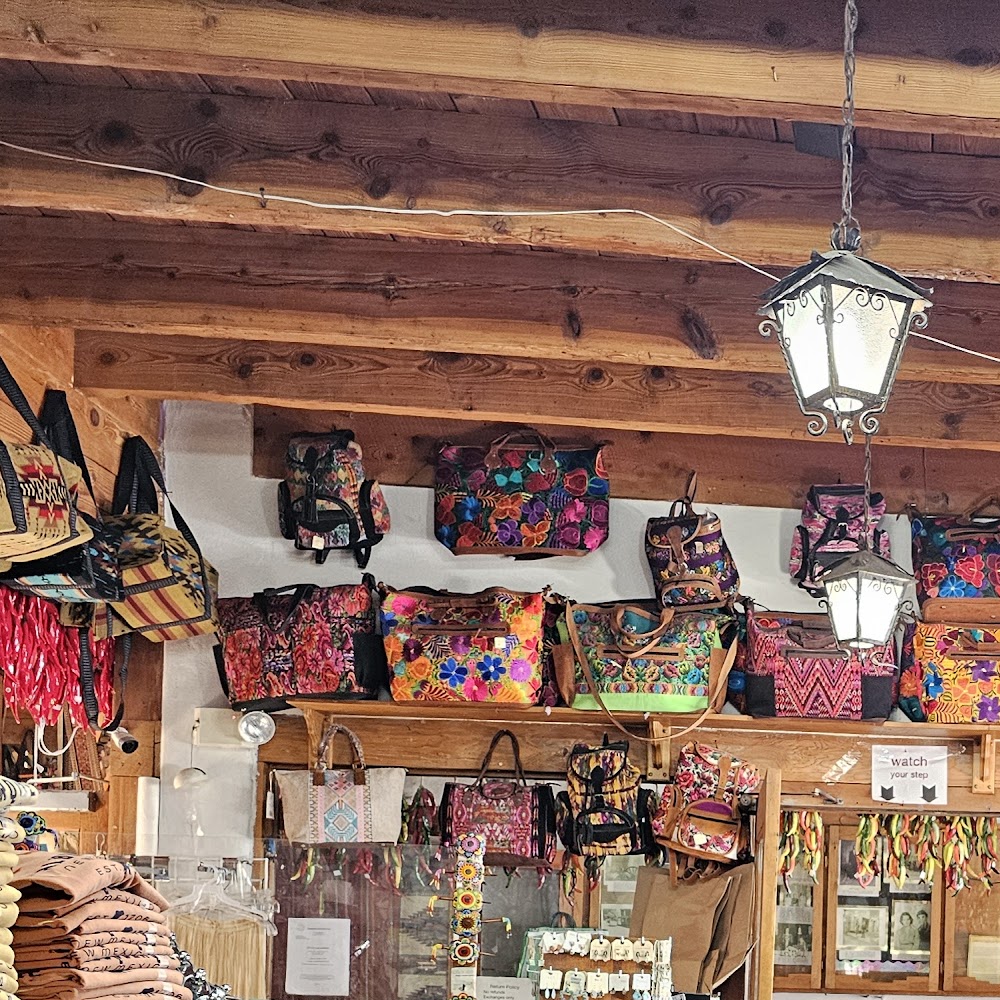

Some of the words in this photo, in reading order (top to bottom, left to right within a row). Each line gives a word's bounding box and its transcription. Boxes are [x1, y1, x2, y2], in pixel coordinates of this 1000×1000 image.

[891, 756, 928, 767] watch
[890, 772, 908, 780] your
[911, 771, 929, 780] step
